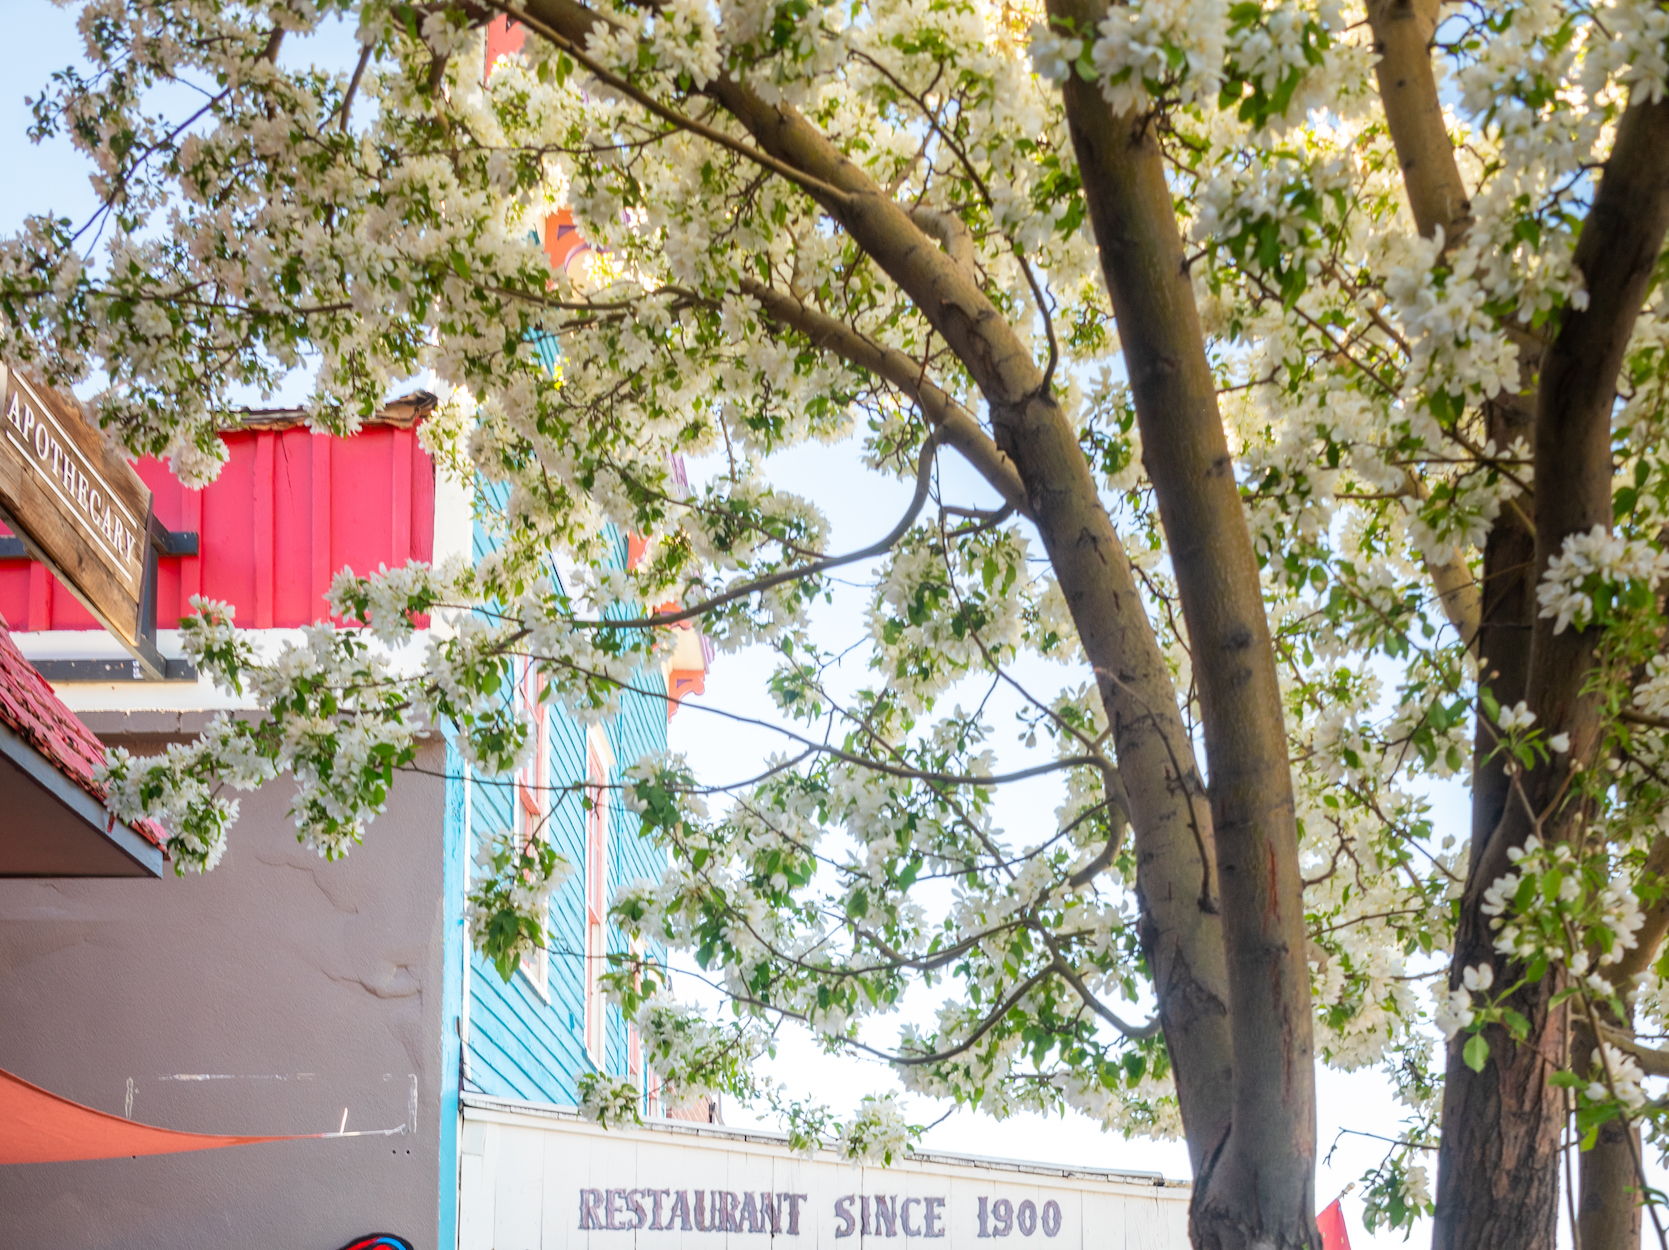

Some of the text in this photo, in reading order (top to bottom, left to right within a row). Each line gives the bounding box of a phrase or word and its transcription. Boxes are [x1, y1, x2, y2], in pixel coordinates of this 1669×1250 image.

[6, 390, 137, 565] APOTHECARY
[578, 1188, 1063, 1239] RESTAURANT SINCE 1900
